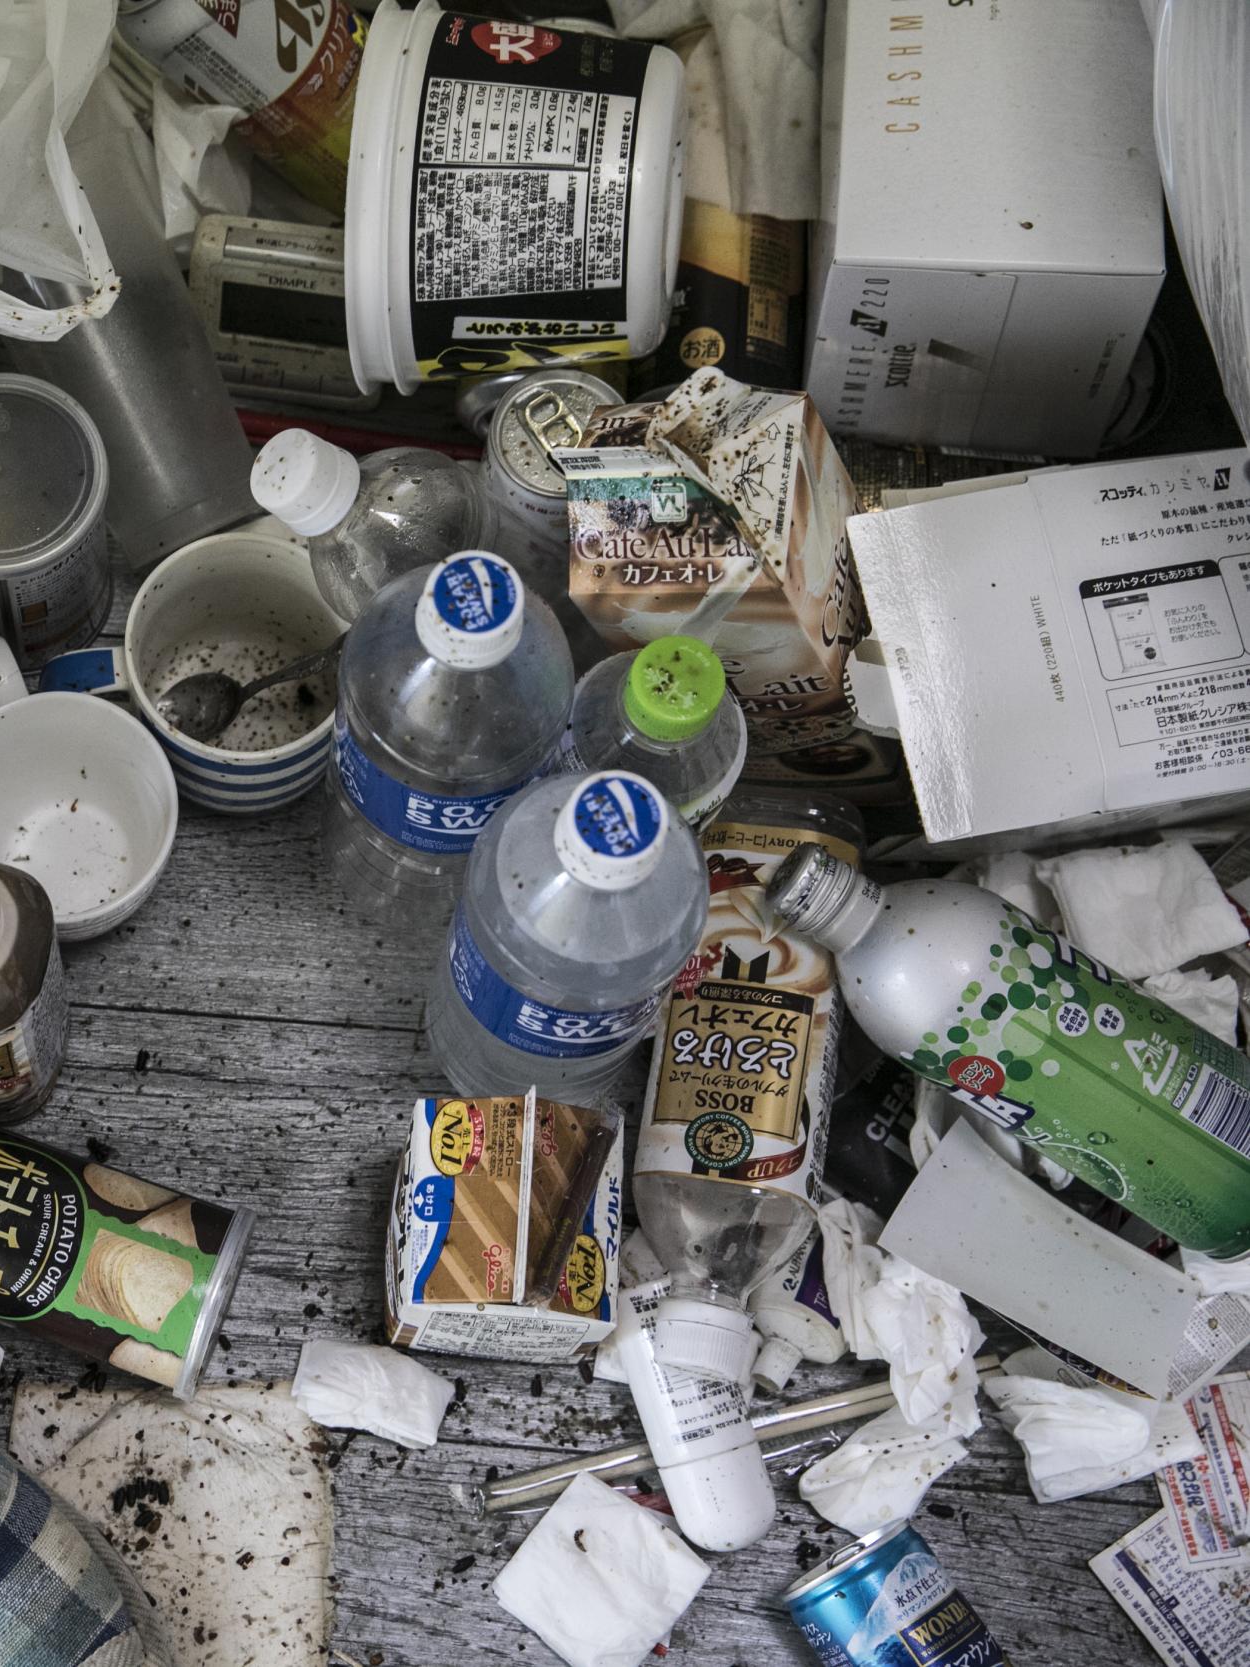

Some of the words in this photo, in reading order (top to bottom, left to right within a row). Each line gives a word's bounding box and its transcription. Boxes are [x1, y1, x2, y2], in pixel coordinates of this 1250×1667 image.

[267, 274, 318, 291] DIMPLE
[604, 269, 612, 280] TEL
[466, 321, 616, 335] とろみがおいしい
[681, 336, 721, 360] お酒
[834, 342, 879, 437] ASHMERE
[860, 276, 890, 309] 220
[883, 343, 918, 391] scottie
[1100, 486, 1145, 502] スコッティ
[1150, 475, 1207, 495] カシミヤ
[650, 527, 697, 560] Au
[622, 563, 724, 585] カフェオ・レ
[1092, 565, 1206, 594] ポケットタイプもあります
[1029, 594, 1047, 630] WHITE
[678, 1004, 800, 1039] カフェオレ
[672, 1029, 799, 1078] とろける
[669, 1069, 790, 1098] ダブルの生クリームで
[694, 1088, 756, 1114] BOSS
[438, 1109, 464, 1172] No.1
[689, 1114, 714, 1135] SUNTORY
[715, 1113, 741, 1126] COFFEE
[741, 1125, 751, 1143] BOSS
[696, 1156, 723, 1168] COFFEE
[724, 1145, 750, 1168] SUNTORY
[747, 1154, 800, 1178] コクUP
[41, 1193, 53, 1221] SOUR
[423, 1183, 435, 1217] あけ口
[60, 1194, 78, 1260] POTATO
[605, 1176, 621, 1259] マイルド
[34, 1222, 50, 1251] CREAM
[9, 1263, 36, 1295] ONION
[25, 1261, 63, 1309] CHIPS
[575, 1240, 599, 1307] No.1
